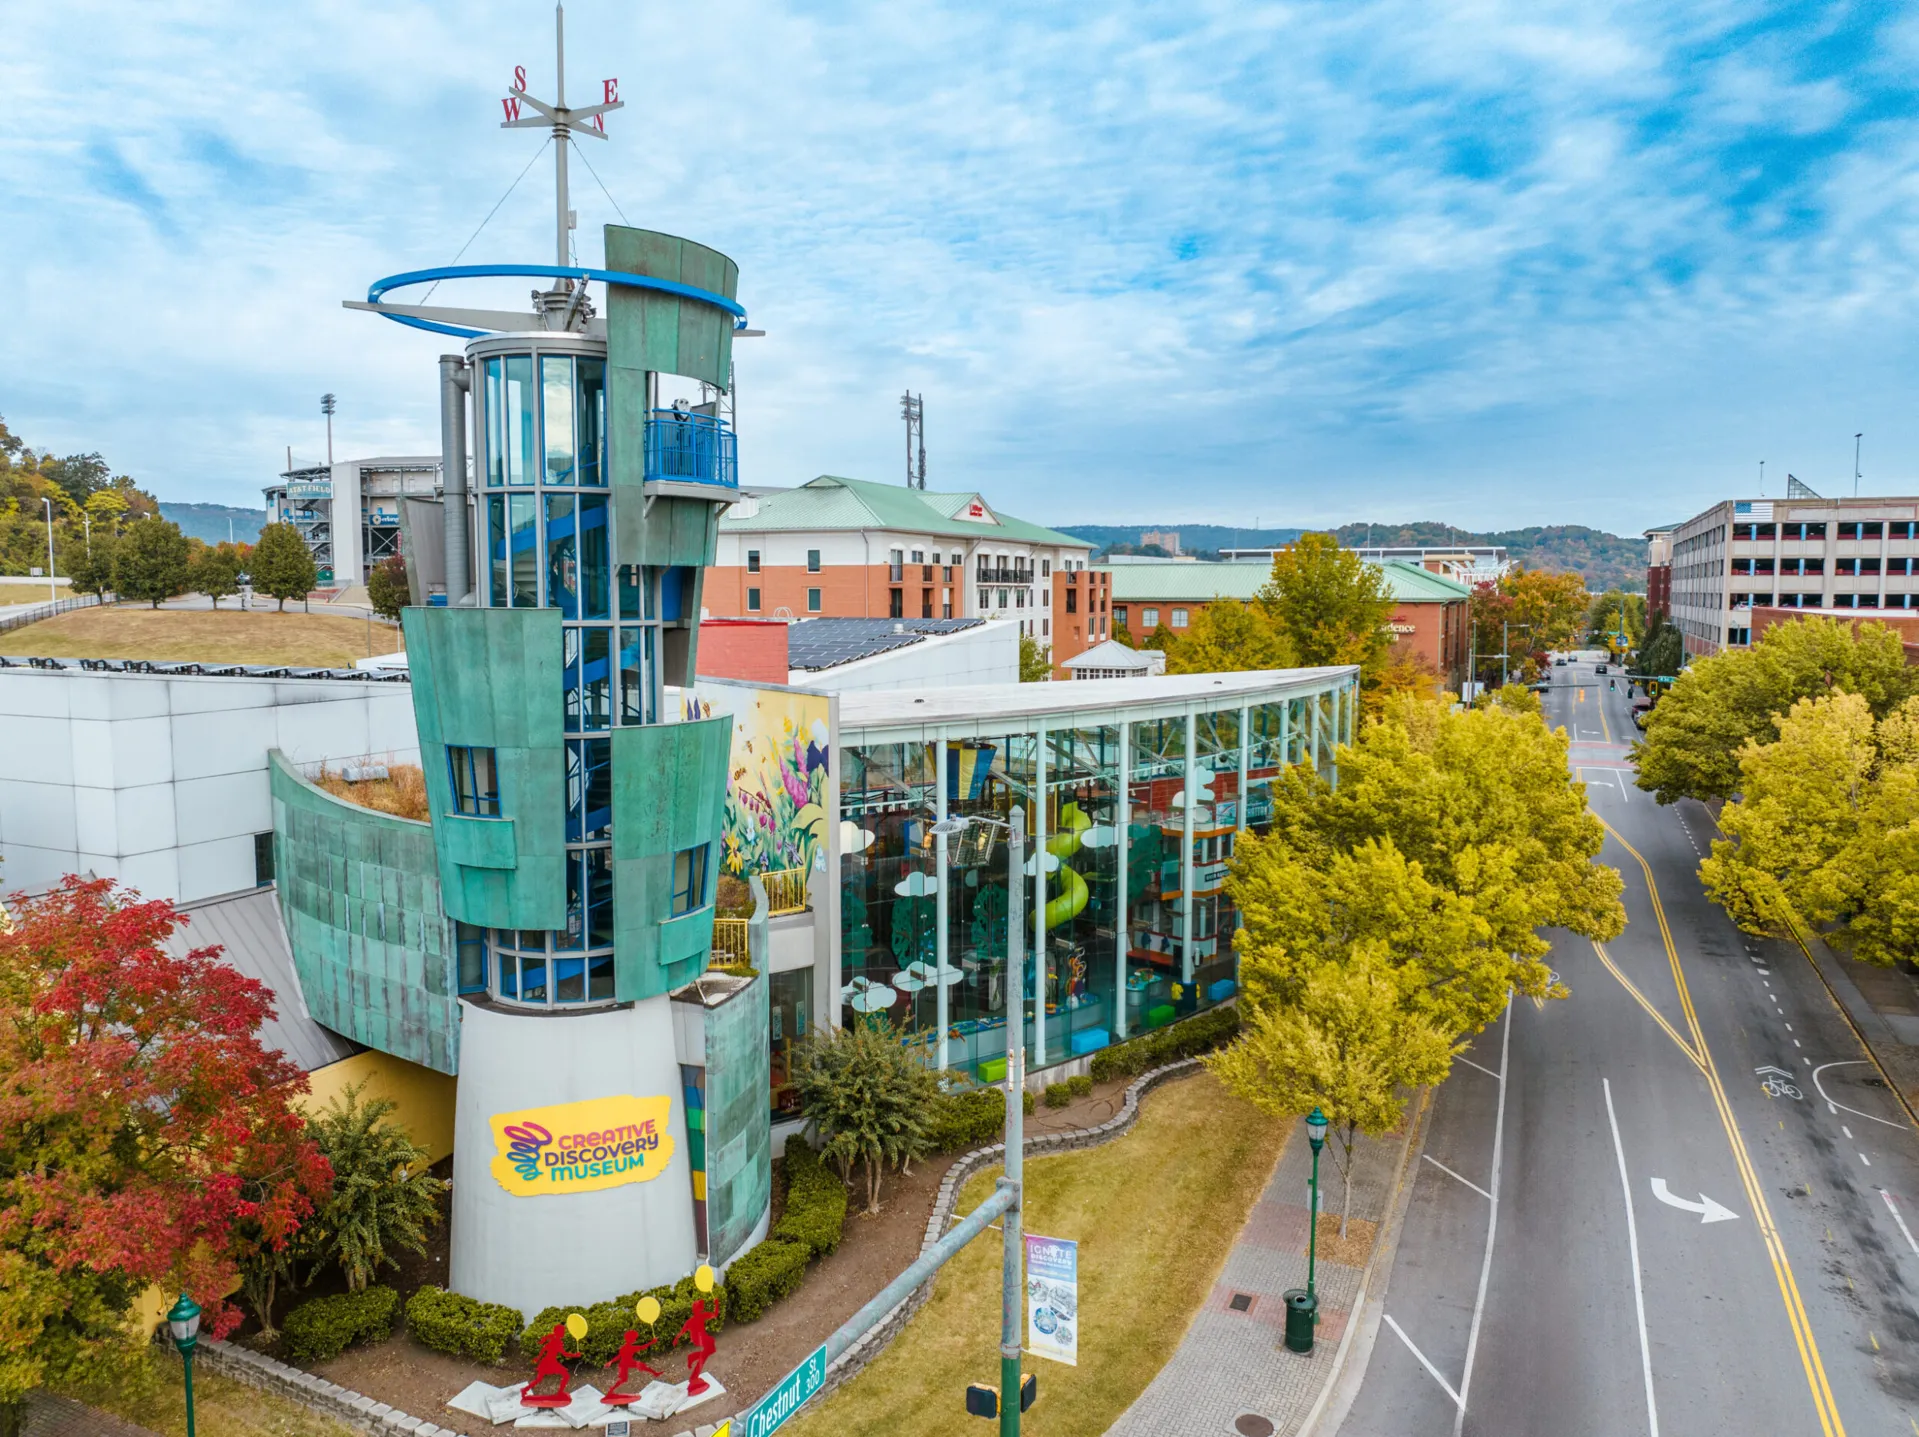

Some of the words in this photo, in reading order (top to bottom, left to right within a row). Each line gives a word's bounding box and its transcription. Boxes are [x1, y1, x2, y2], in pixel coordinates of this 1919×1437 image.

[514, 65, 526, 93] S
[602, 77, 618, 104] E
[501, 97, 522, 122] W
[593, 111, 604, 132] N
[289, 485, 306, 494] AT&T
[308, 485, 330, 493] FIELD
[1378, 623, 1416, 633] sidence
[558, 1119, 656, 1150] CREATIVE
[545, 1133, 659, 1166] DISCOVERY
[551, 1153, 645, 1181] MUSEUM
[1031, 1253, 1072, 1266] DISCOVERY
[806, 1370, 820, 1394] 300
[750, 1373, 800, 1437] Chestnut
[809, 1357, 817, 1375] St
